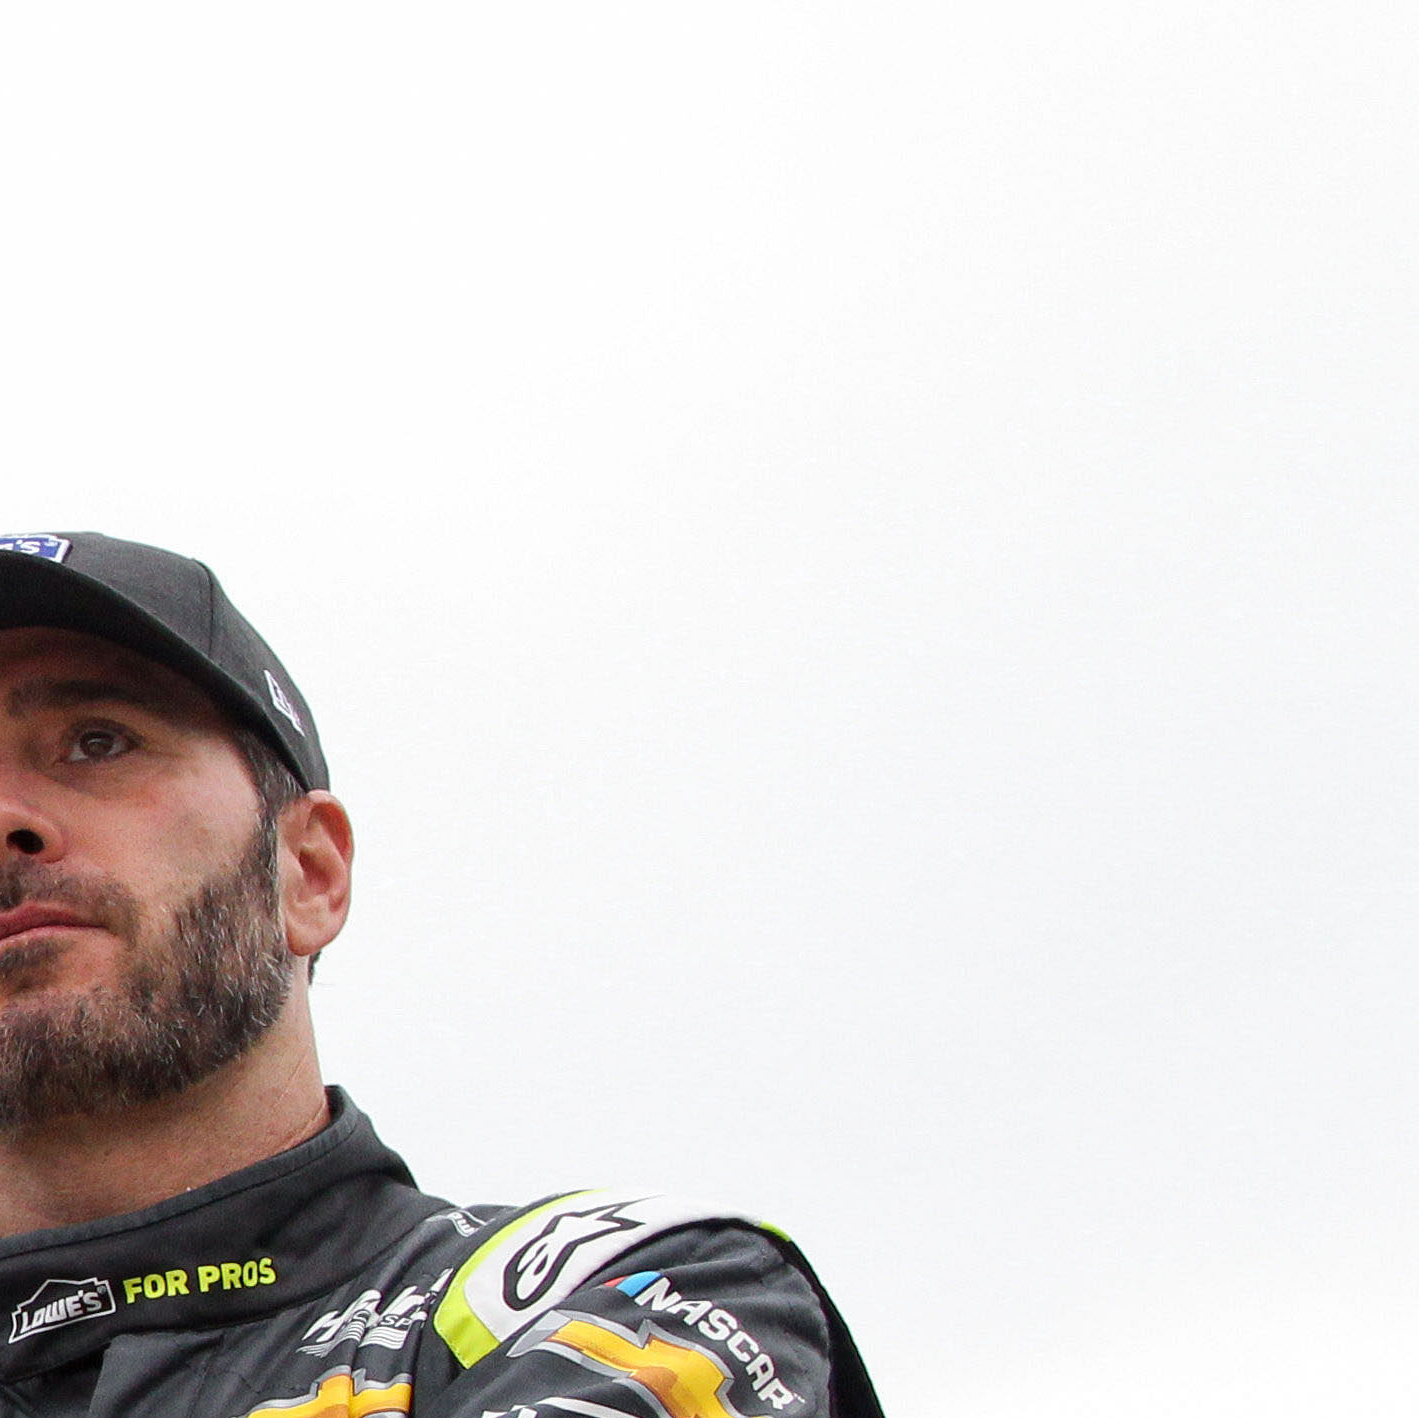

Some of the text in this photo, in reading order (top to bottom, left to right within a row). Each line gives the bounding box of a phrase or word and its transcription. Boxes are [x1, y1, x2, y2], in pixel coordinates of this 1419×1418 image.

[20, 1257, 277, 1334] LOWE'S FOR PROS
[634, 1276, 795, 1410] NASCAR
